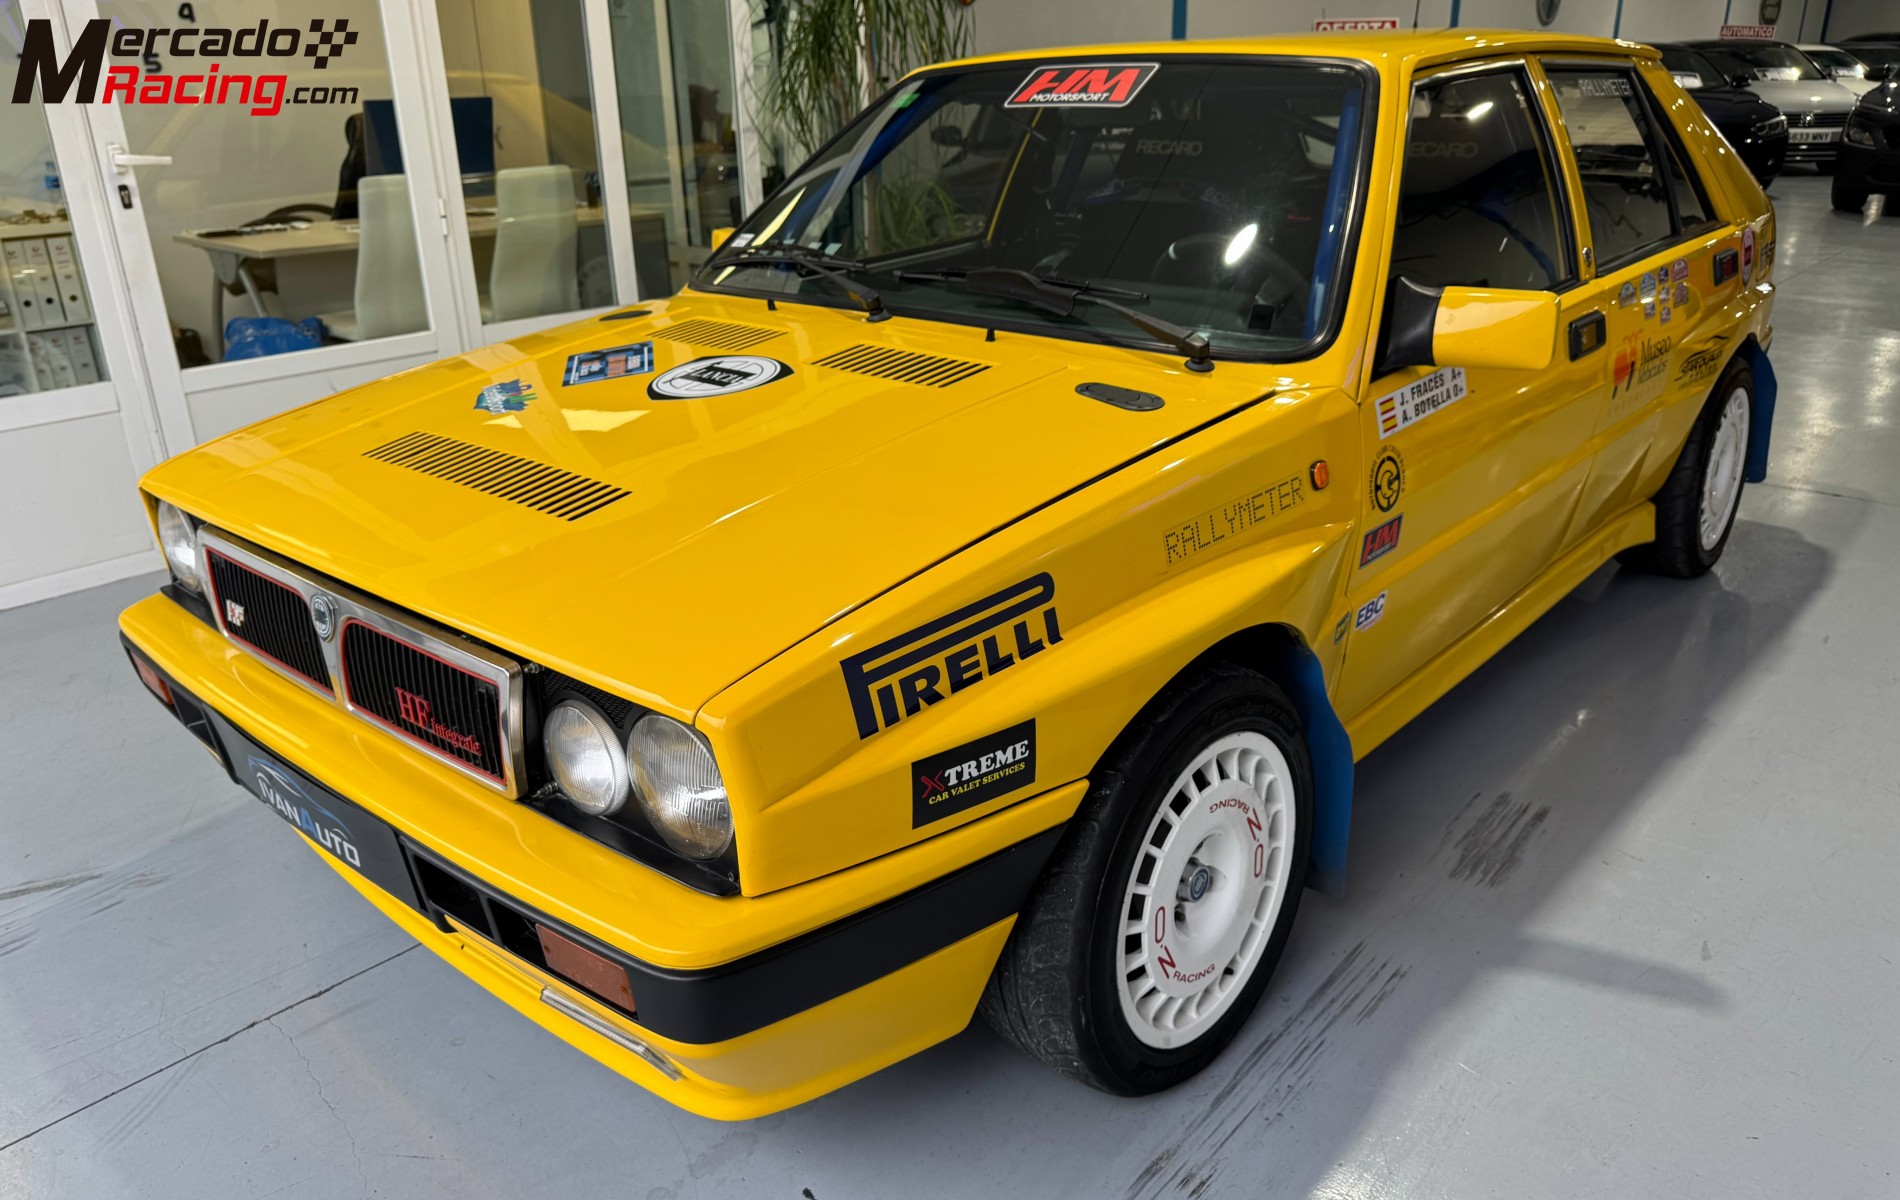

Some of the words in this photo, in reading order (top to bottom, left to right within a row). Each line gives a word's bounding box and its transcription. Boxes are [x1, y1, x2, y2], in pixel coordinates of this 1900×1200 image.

[1013, 68, 1141, 103] HM
[1029, 92, 1110, 102] MOTORSPORT
[1136, 139, 1203, 156] RECARO
[1407, 141, 1479, 159] ECARO
[1640, 336, 1672, 367] Museo
[1400, 391, 1409, 406] J.
[1411, 372, 1445, 400] FRACÉS
[1450, 368, 1462, 381] A+
[1402, 409, 1412, 424] A.
[1414, 388, 1451, 417] BOTELLA
[1164, 475, 1304, 564] RALLYMETER
[1361, 518, 1399, 565] HM
[1355, 593, 1386, 629] EBC
[839, 571, 1064, 741] PIRELLI
[395, 687, 431, 730] HF
[430, 717, 482, 756] integrale
[928, 791, 950, 805] CAR
[950, 779, 981, 797] VALET
[982, 761, 1026, 785] SERVICES
[1209, 798, 1250, 815] RACING
[1173, 963, 1216, 984] RACING
